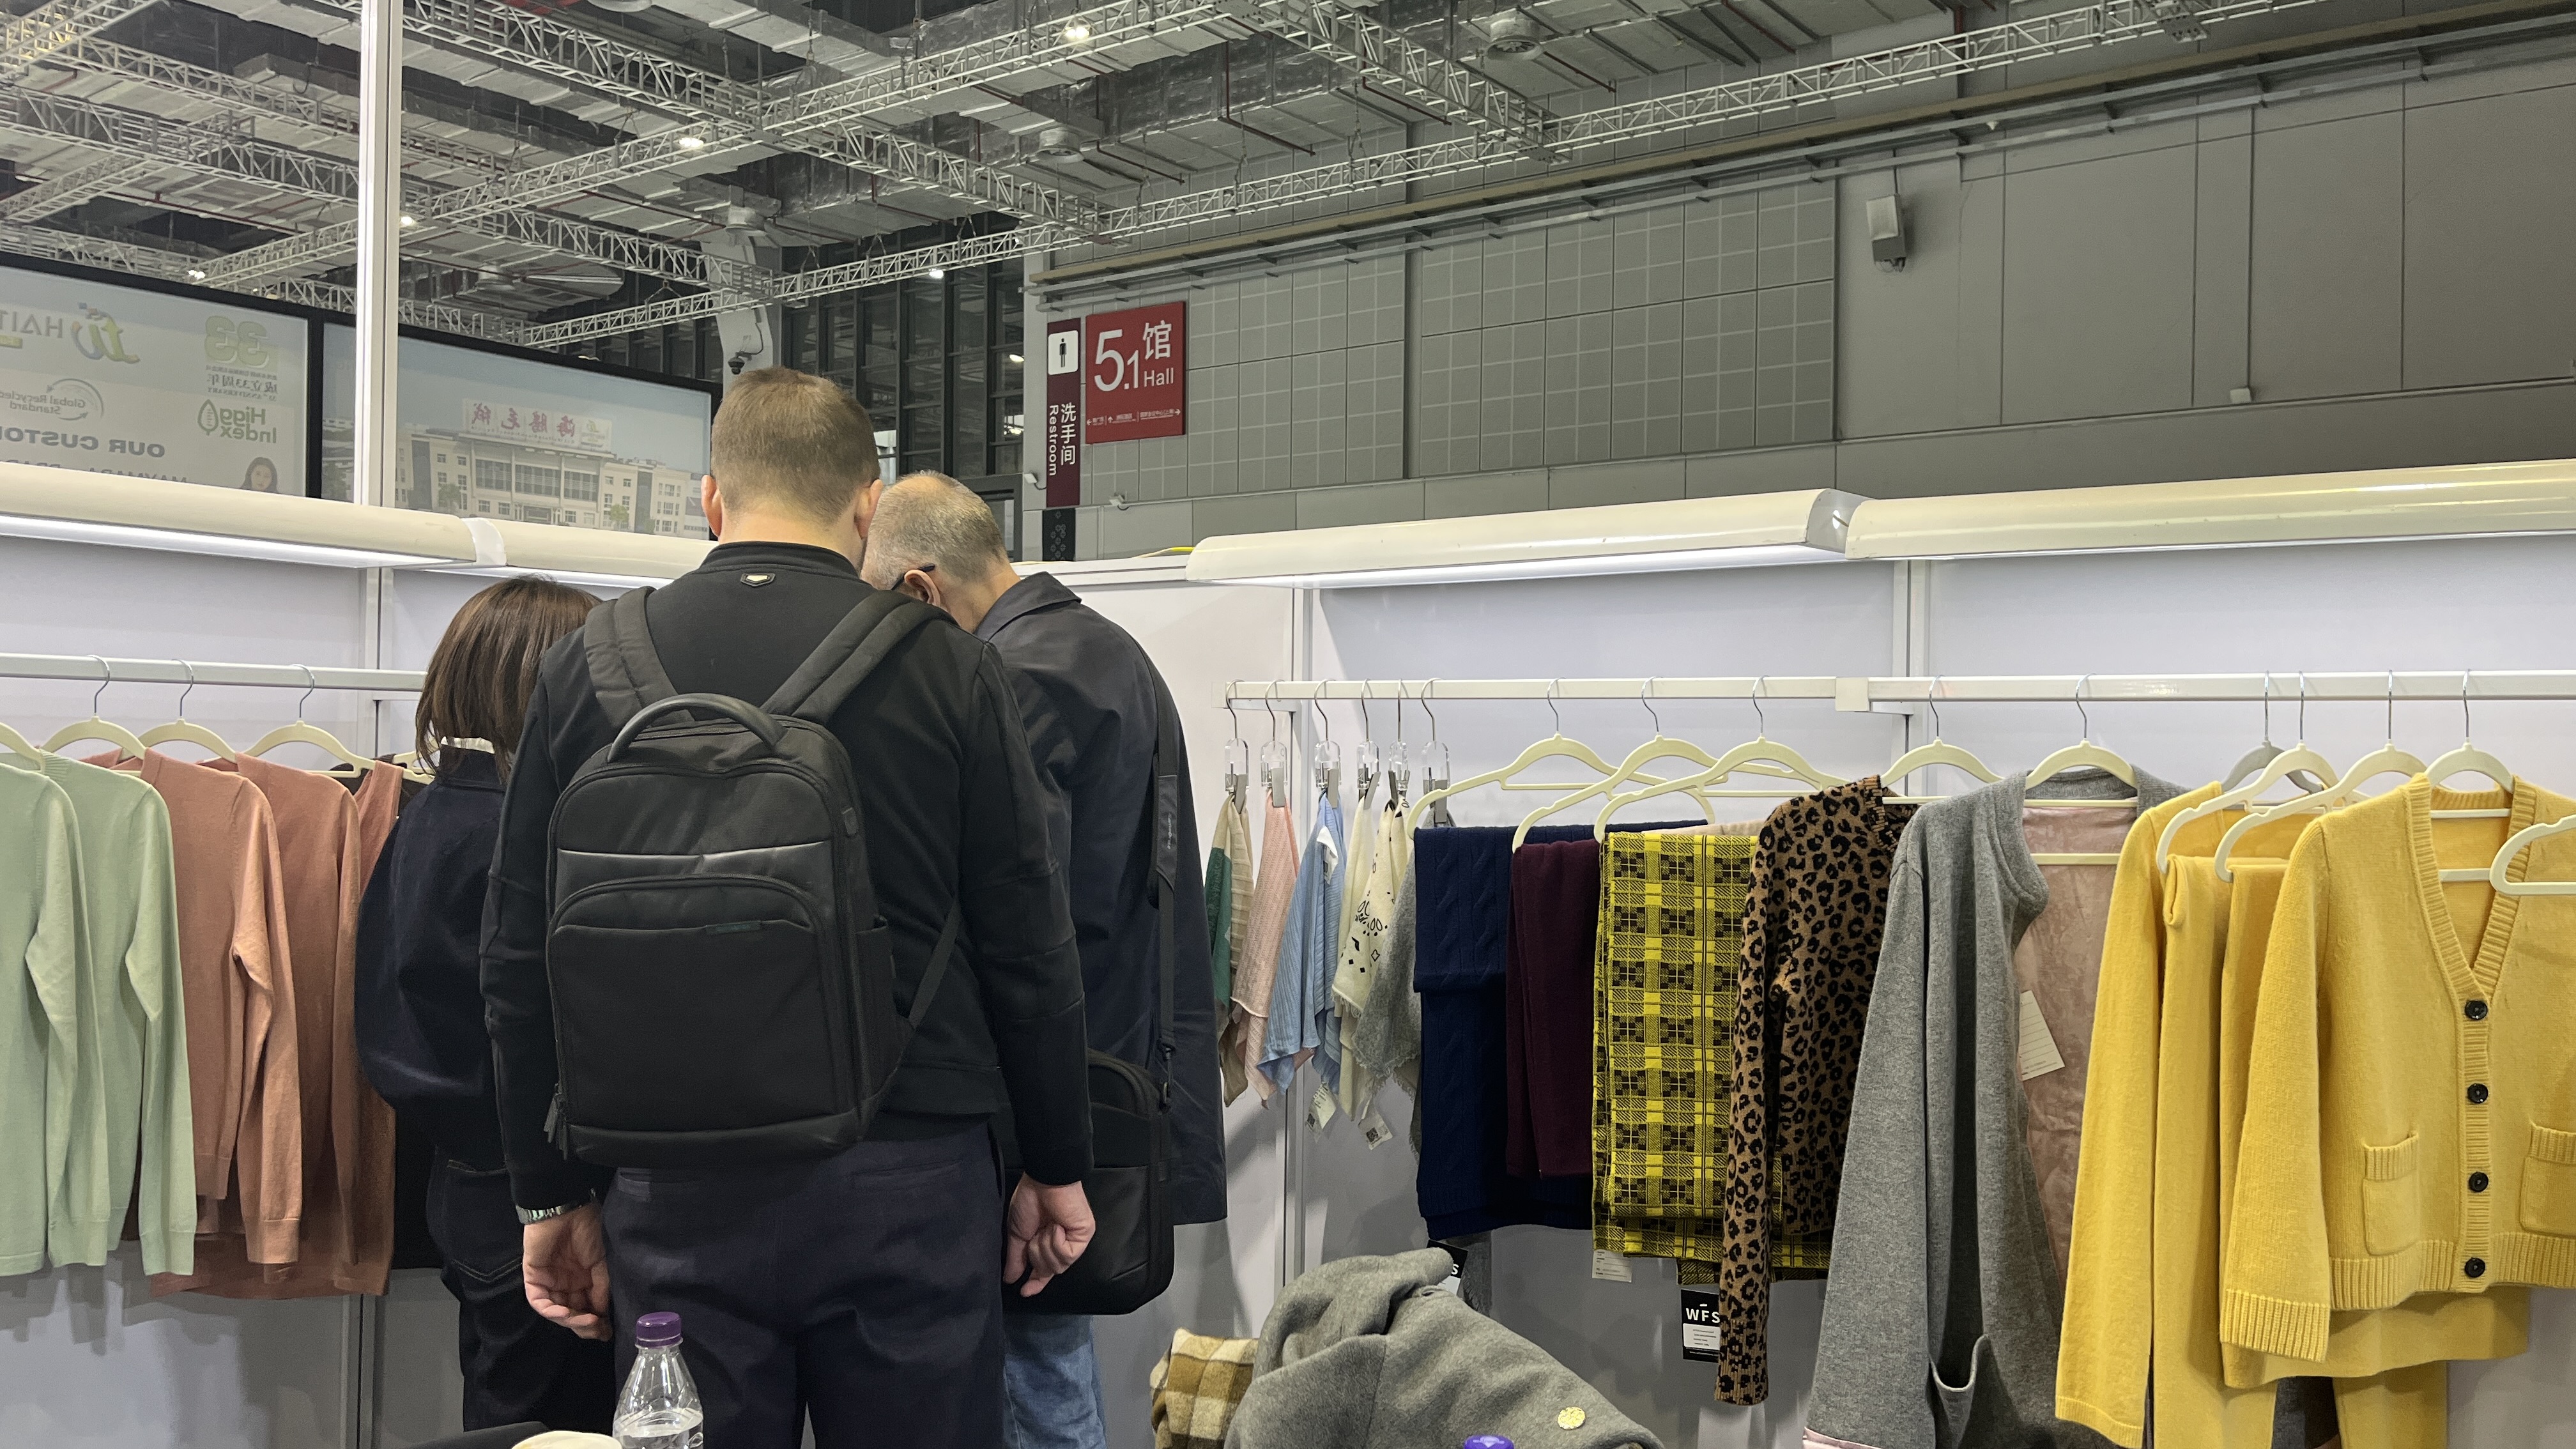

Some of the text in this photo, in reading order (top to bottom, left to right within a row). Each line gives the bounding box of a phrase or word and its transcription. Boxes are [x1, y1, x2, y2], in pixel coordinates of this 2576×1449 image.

[1094, 328, 1140, 392] 5.1
[1142, 319, 1172, 360] 馆
[1144, 367, 1174, 388] Hall
[1048, 404, 1059, 477] Restroom
[1061, 402, 1077, 466] 洗手间
[1685, 1307, 1721, 1324] WFS
